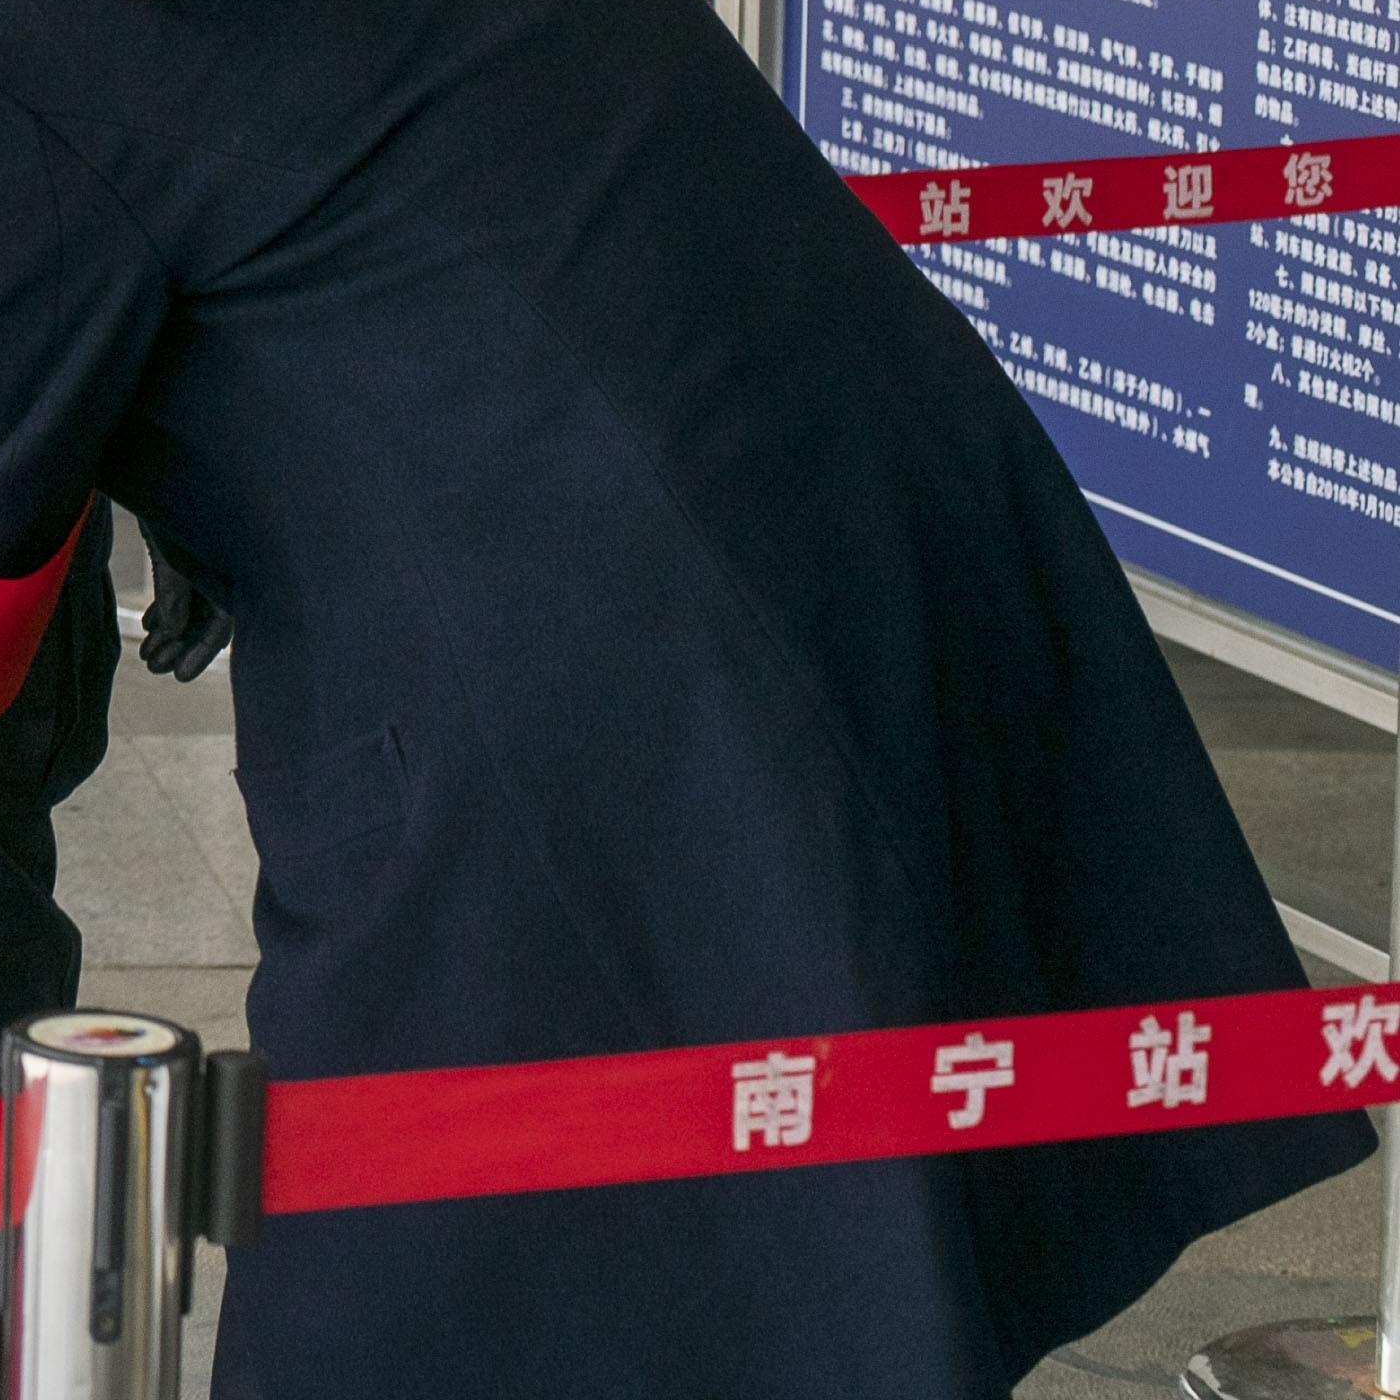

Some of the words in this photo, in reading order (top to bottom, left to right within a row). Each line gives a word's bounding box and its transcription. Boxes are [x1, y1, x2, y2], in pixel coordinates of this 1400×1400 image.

[919, 151, 1334, 237] 站欢迎您
[731, 995, 1400, 1151] 南宁站欢
